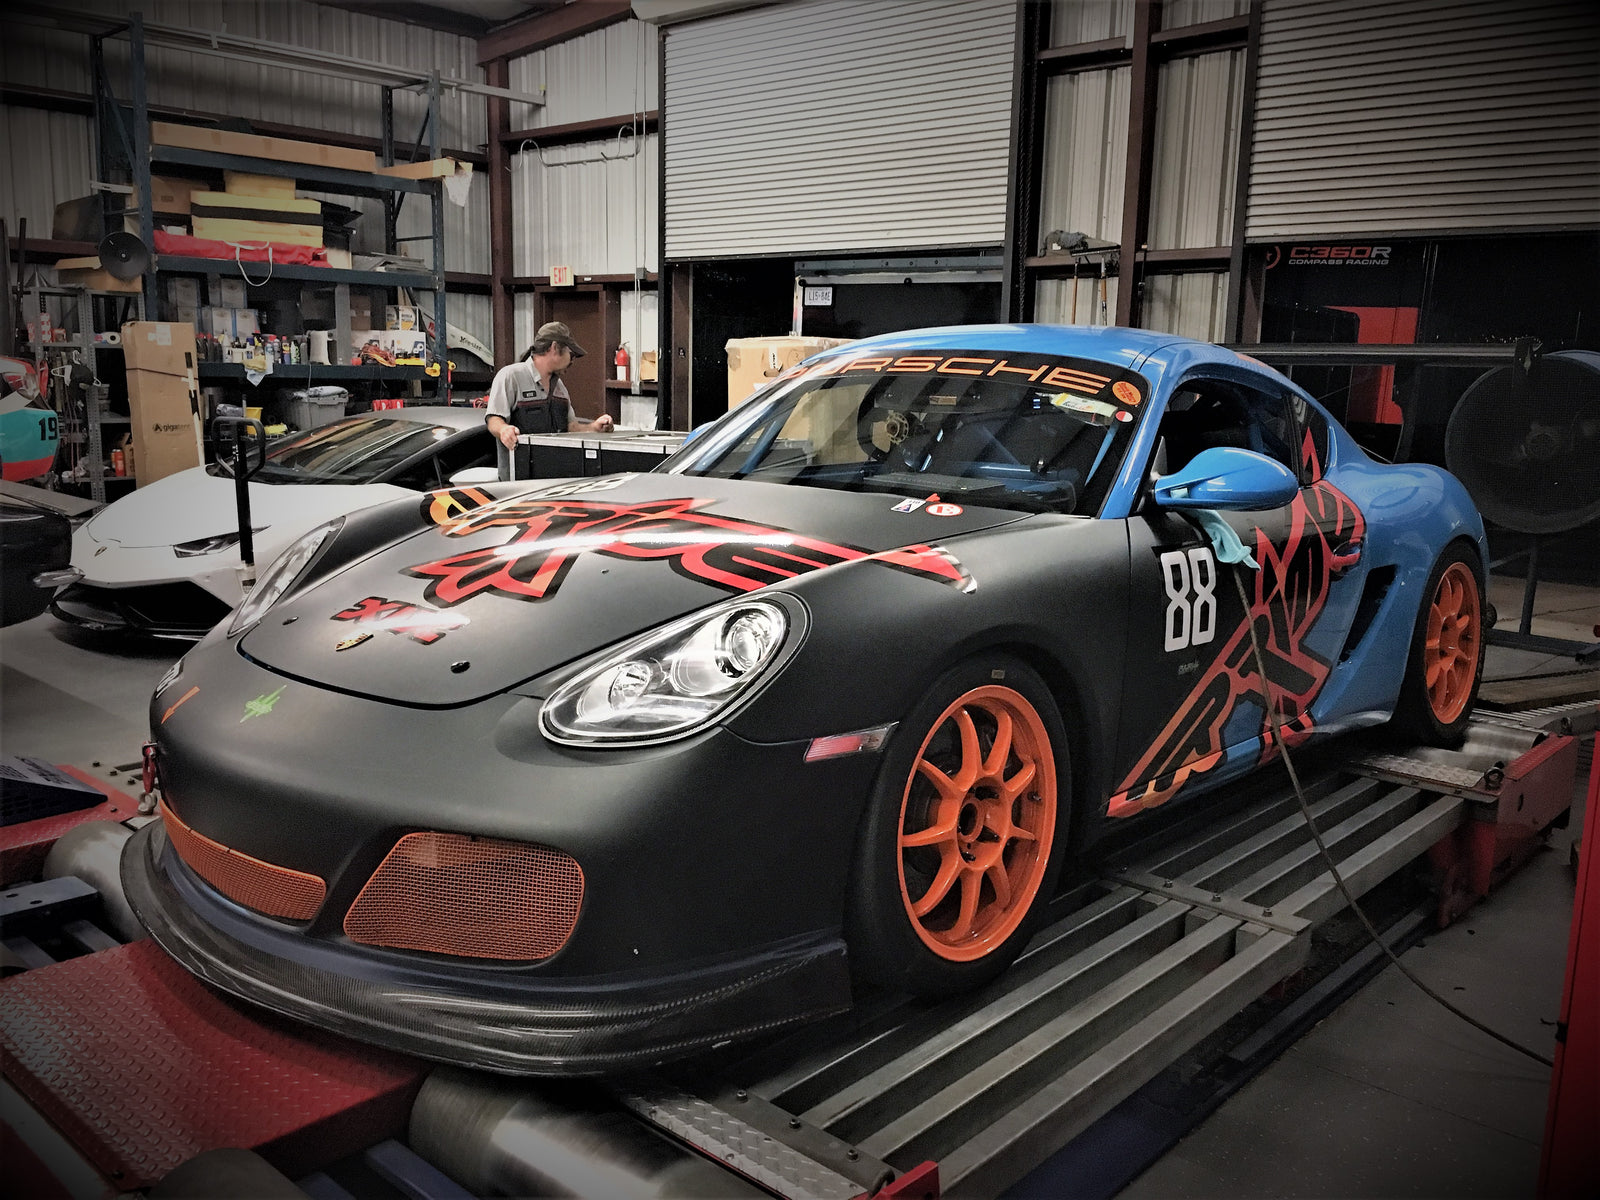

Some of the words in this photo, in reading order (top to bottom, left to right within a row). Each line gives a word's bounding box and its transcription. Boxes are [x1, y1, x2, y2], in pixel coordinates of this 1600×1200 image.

[1290, 246, 1392, 259] C360R
[1288, 258, 1344, 266] COMPASS
[1345, 258, 1390, 266] RACING
[553, 266, 567, 284] EXIT
[38, 416, 58, 441] 19
[1161, 547, 1217, 652] 88
